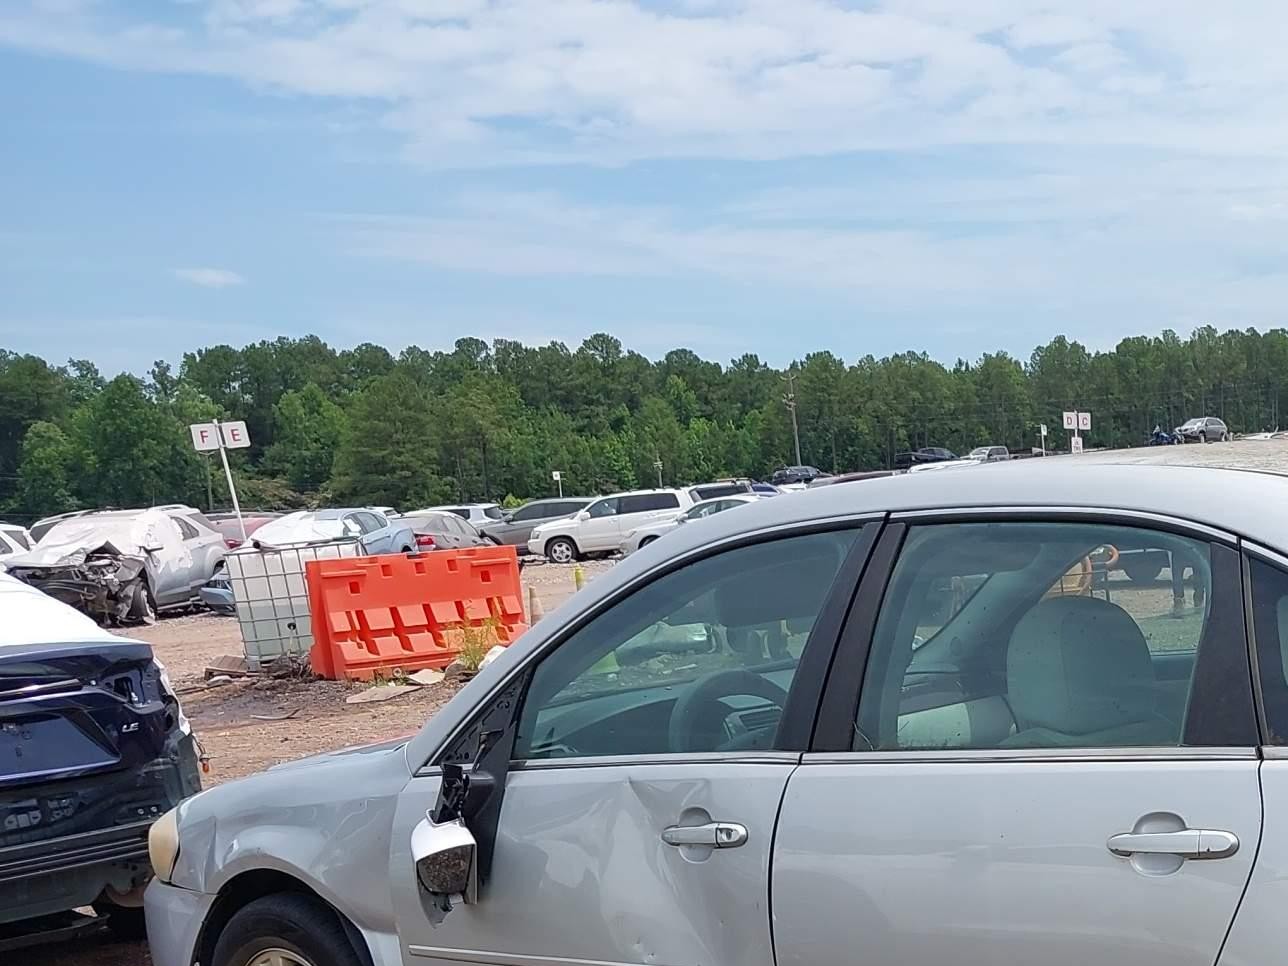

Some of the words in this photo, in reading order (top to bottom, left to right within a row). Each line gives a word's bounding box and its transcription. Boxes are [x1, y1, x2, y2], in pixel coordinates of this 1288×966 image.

[1066, 416, 1073, 426] D
[1082, 416, 1088, 426] C
[199, 430, 209, 444] F
[230, 428, 242, 442] E
[121, 722, 140, 733] LE
